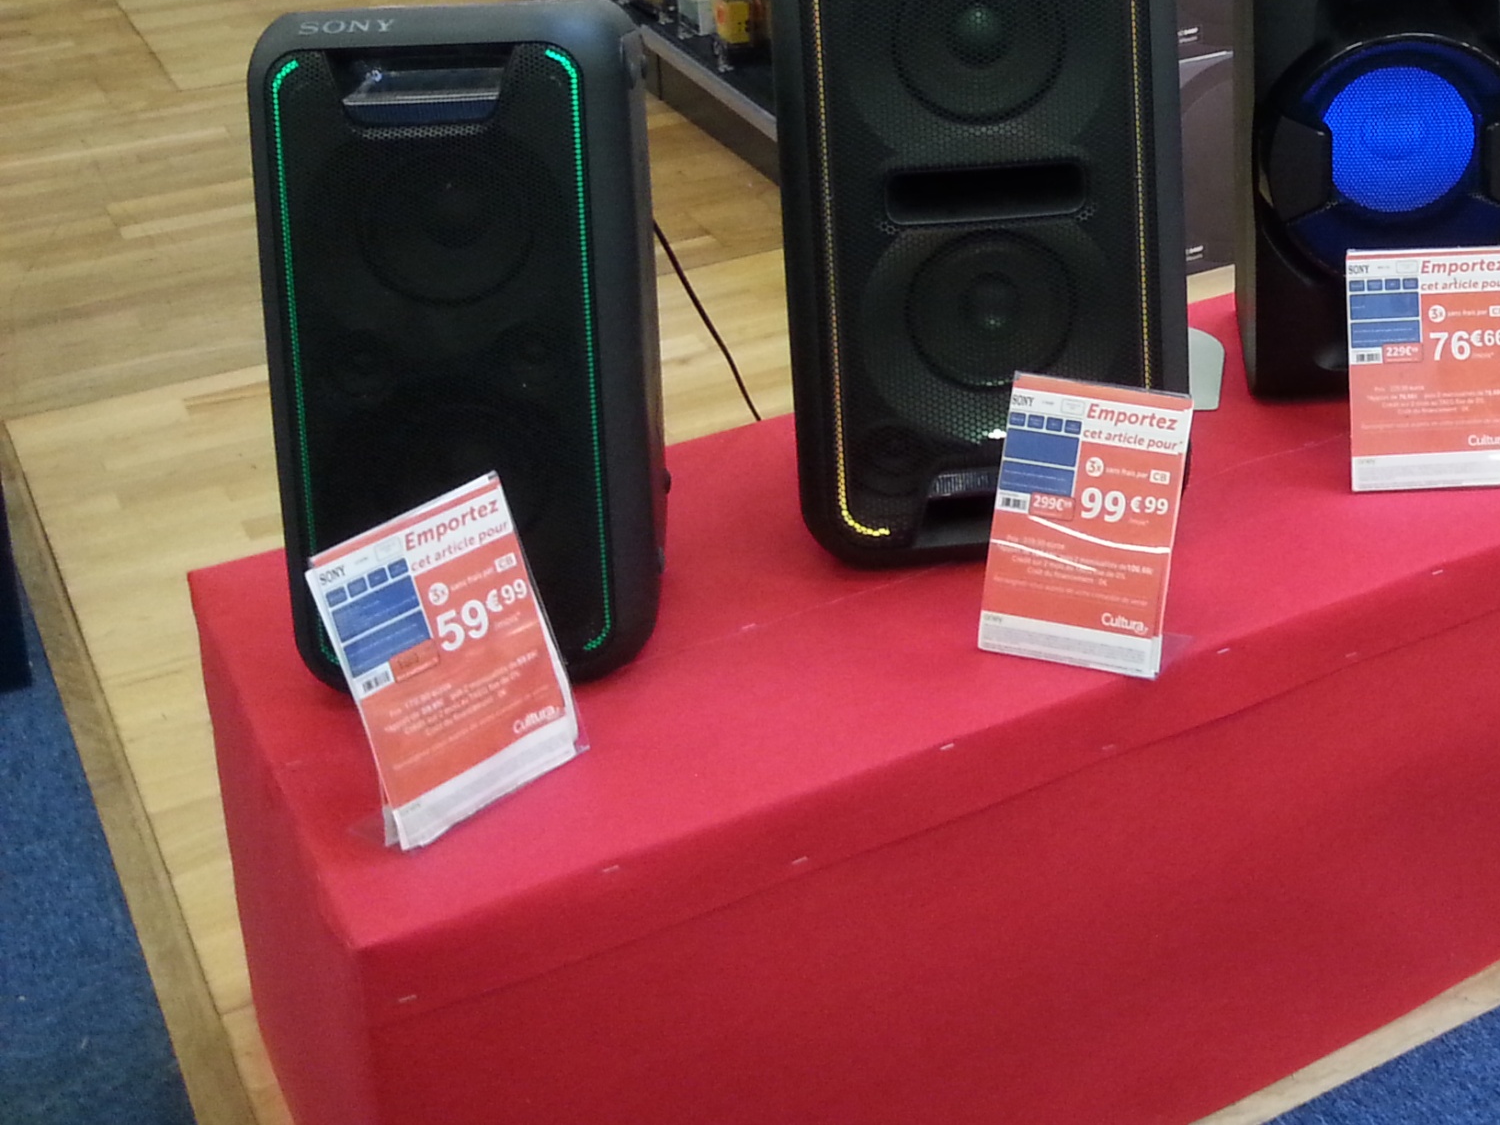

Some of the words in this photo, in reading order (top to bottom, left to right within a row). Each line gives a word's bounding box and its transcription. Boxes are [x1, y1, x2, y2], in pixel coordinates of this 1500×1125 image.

[298, 19, 395, 35] SONY
[1421, 281, 1439, 291] cet
[1441, 279, 1479, 289] article
[1012, 394, 1035, 407] SONY
[1086, 402, 1178, 431] Emportez
[1083, 428, 1103, 439] cet
[1105, 430, 1145, 446] article
[403, 497, 500, 552] Emportez
[411, 555, 431, 573] cet
[434, 536, 476, 562] article
[478, 520, 509, 546] pour
[318, 564, 346, 587] SONY
[1101, 612, 1146, 634] Cultura
[513, 704, 558, 734] Cultura
